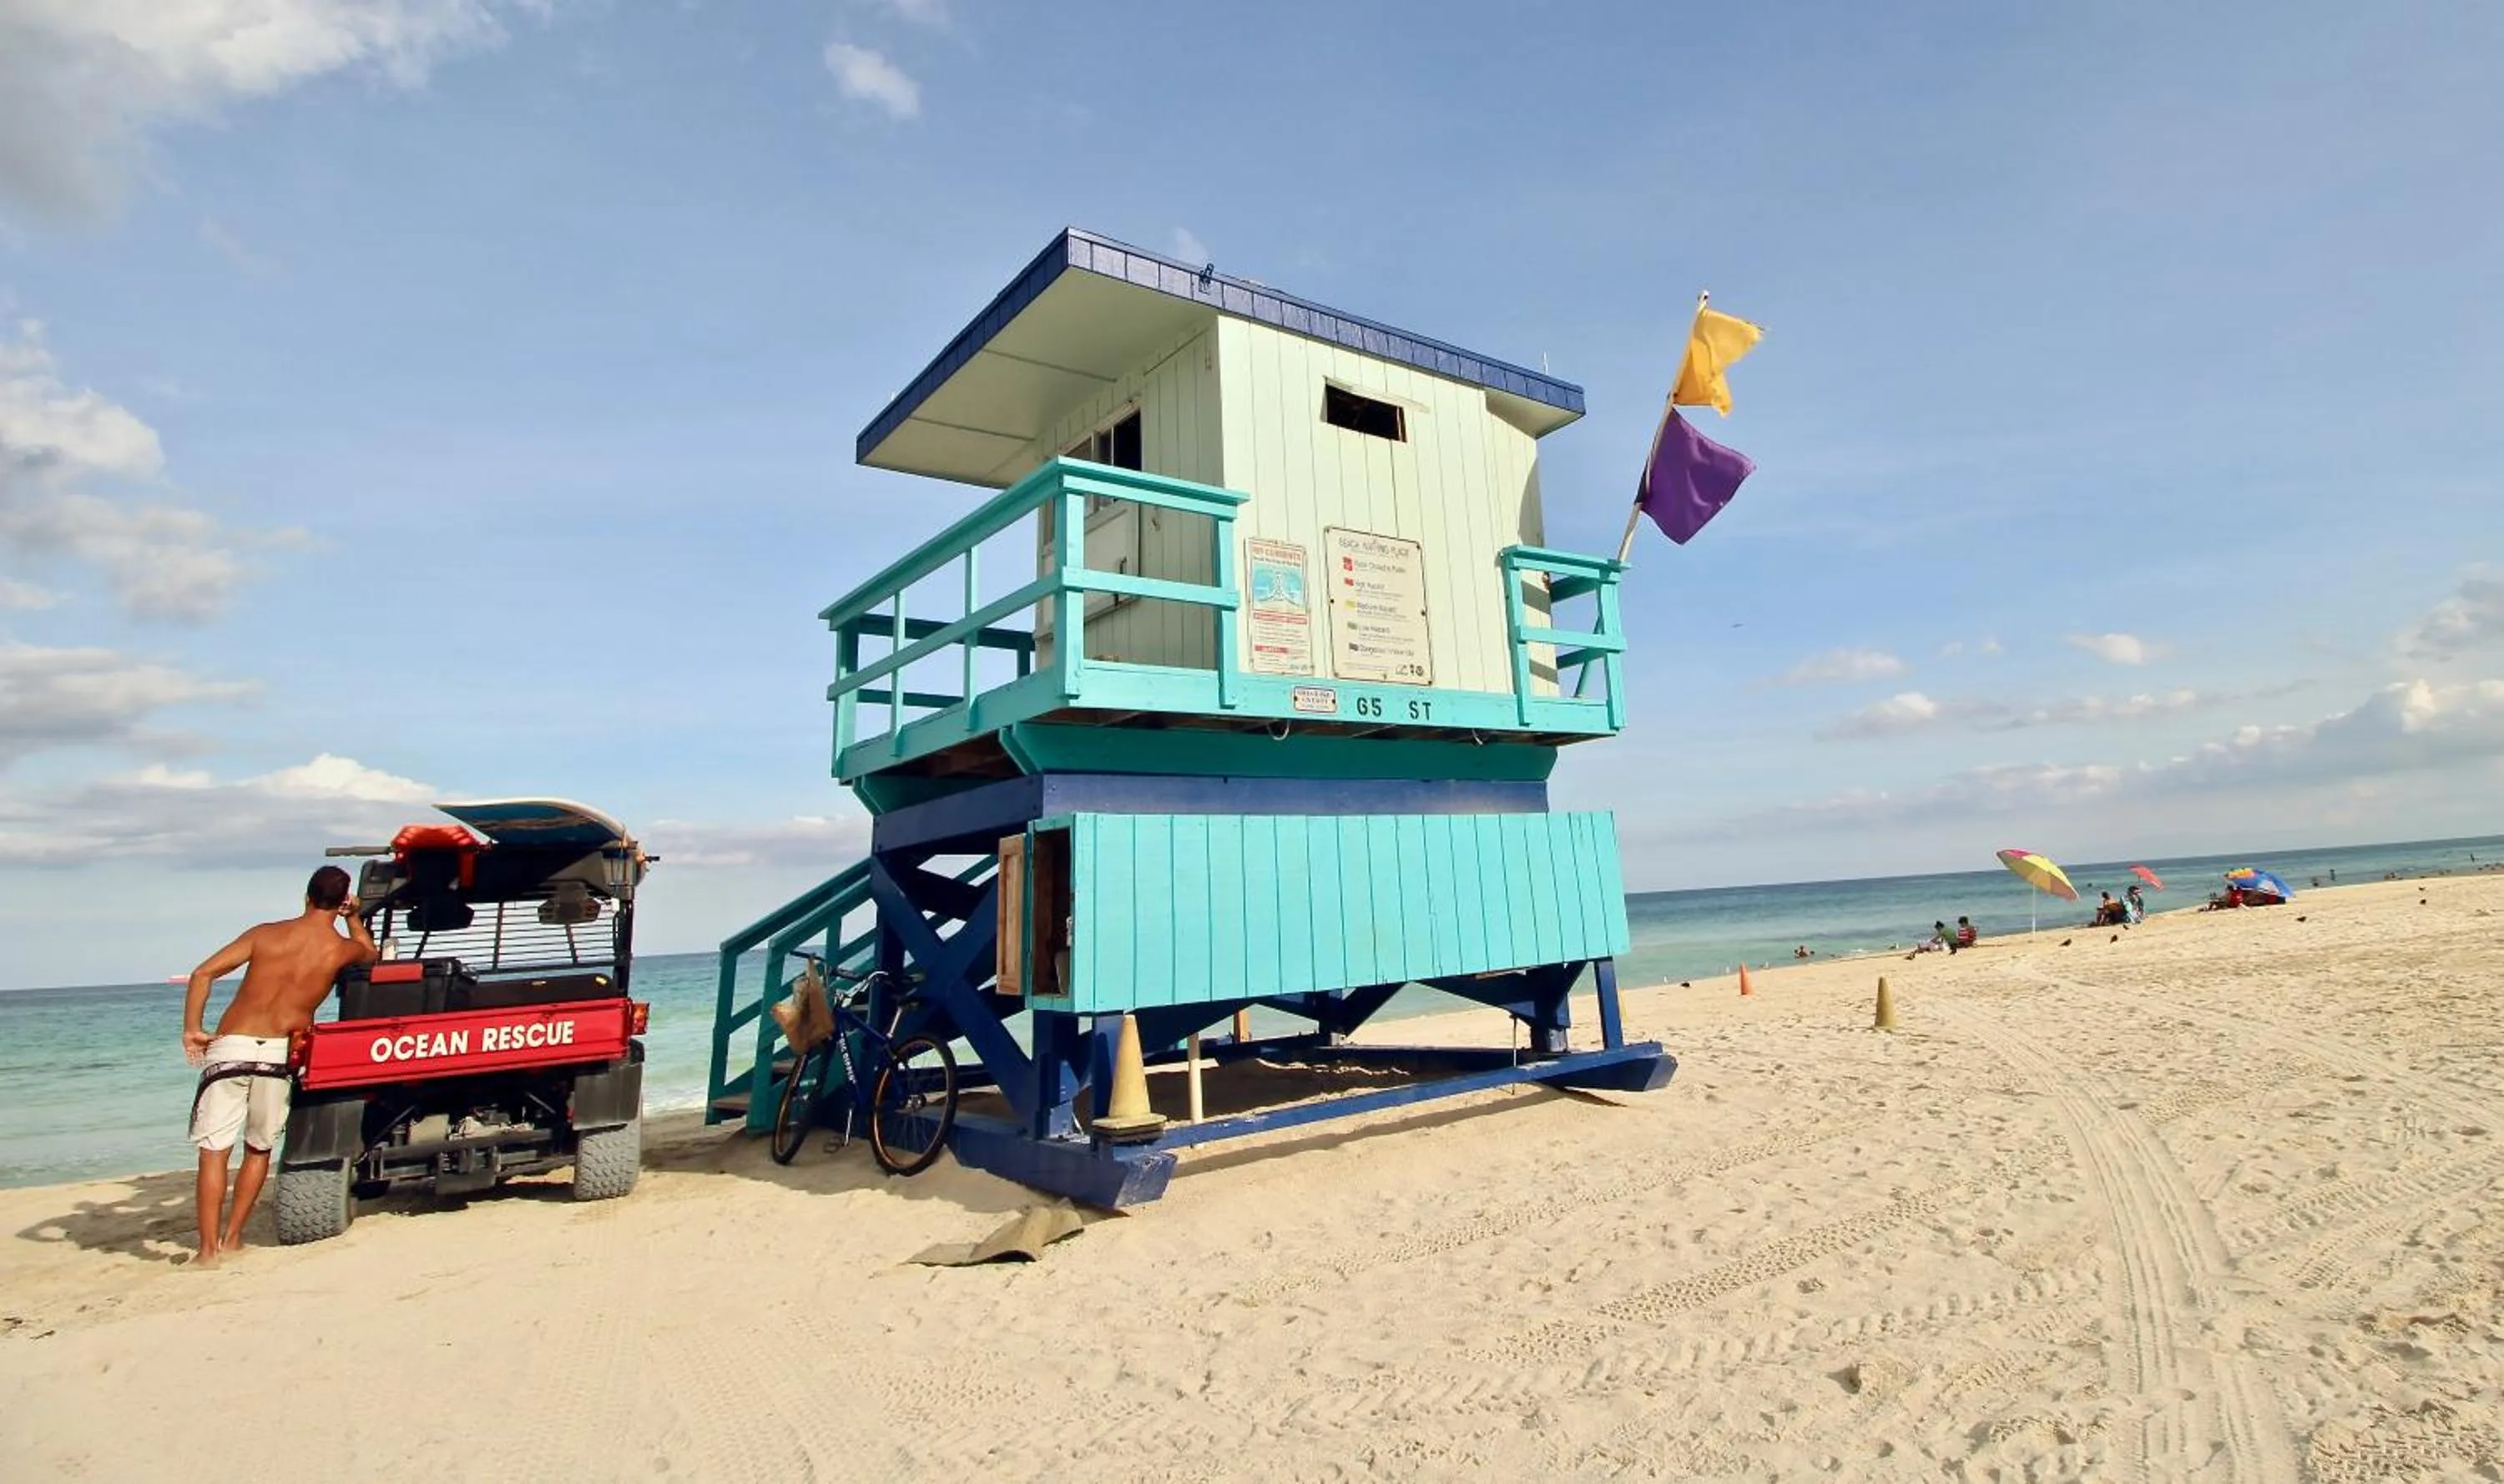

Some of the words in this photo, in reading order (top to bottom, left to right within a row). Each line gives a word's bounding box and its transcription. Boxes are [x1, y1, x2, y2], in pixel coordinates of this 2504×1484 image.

[1408, 699, 1431, 720] ST
[370, 1029, 470, 1063] OCEAN
[482, 1020, 575, 1052] RESCUE
